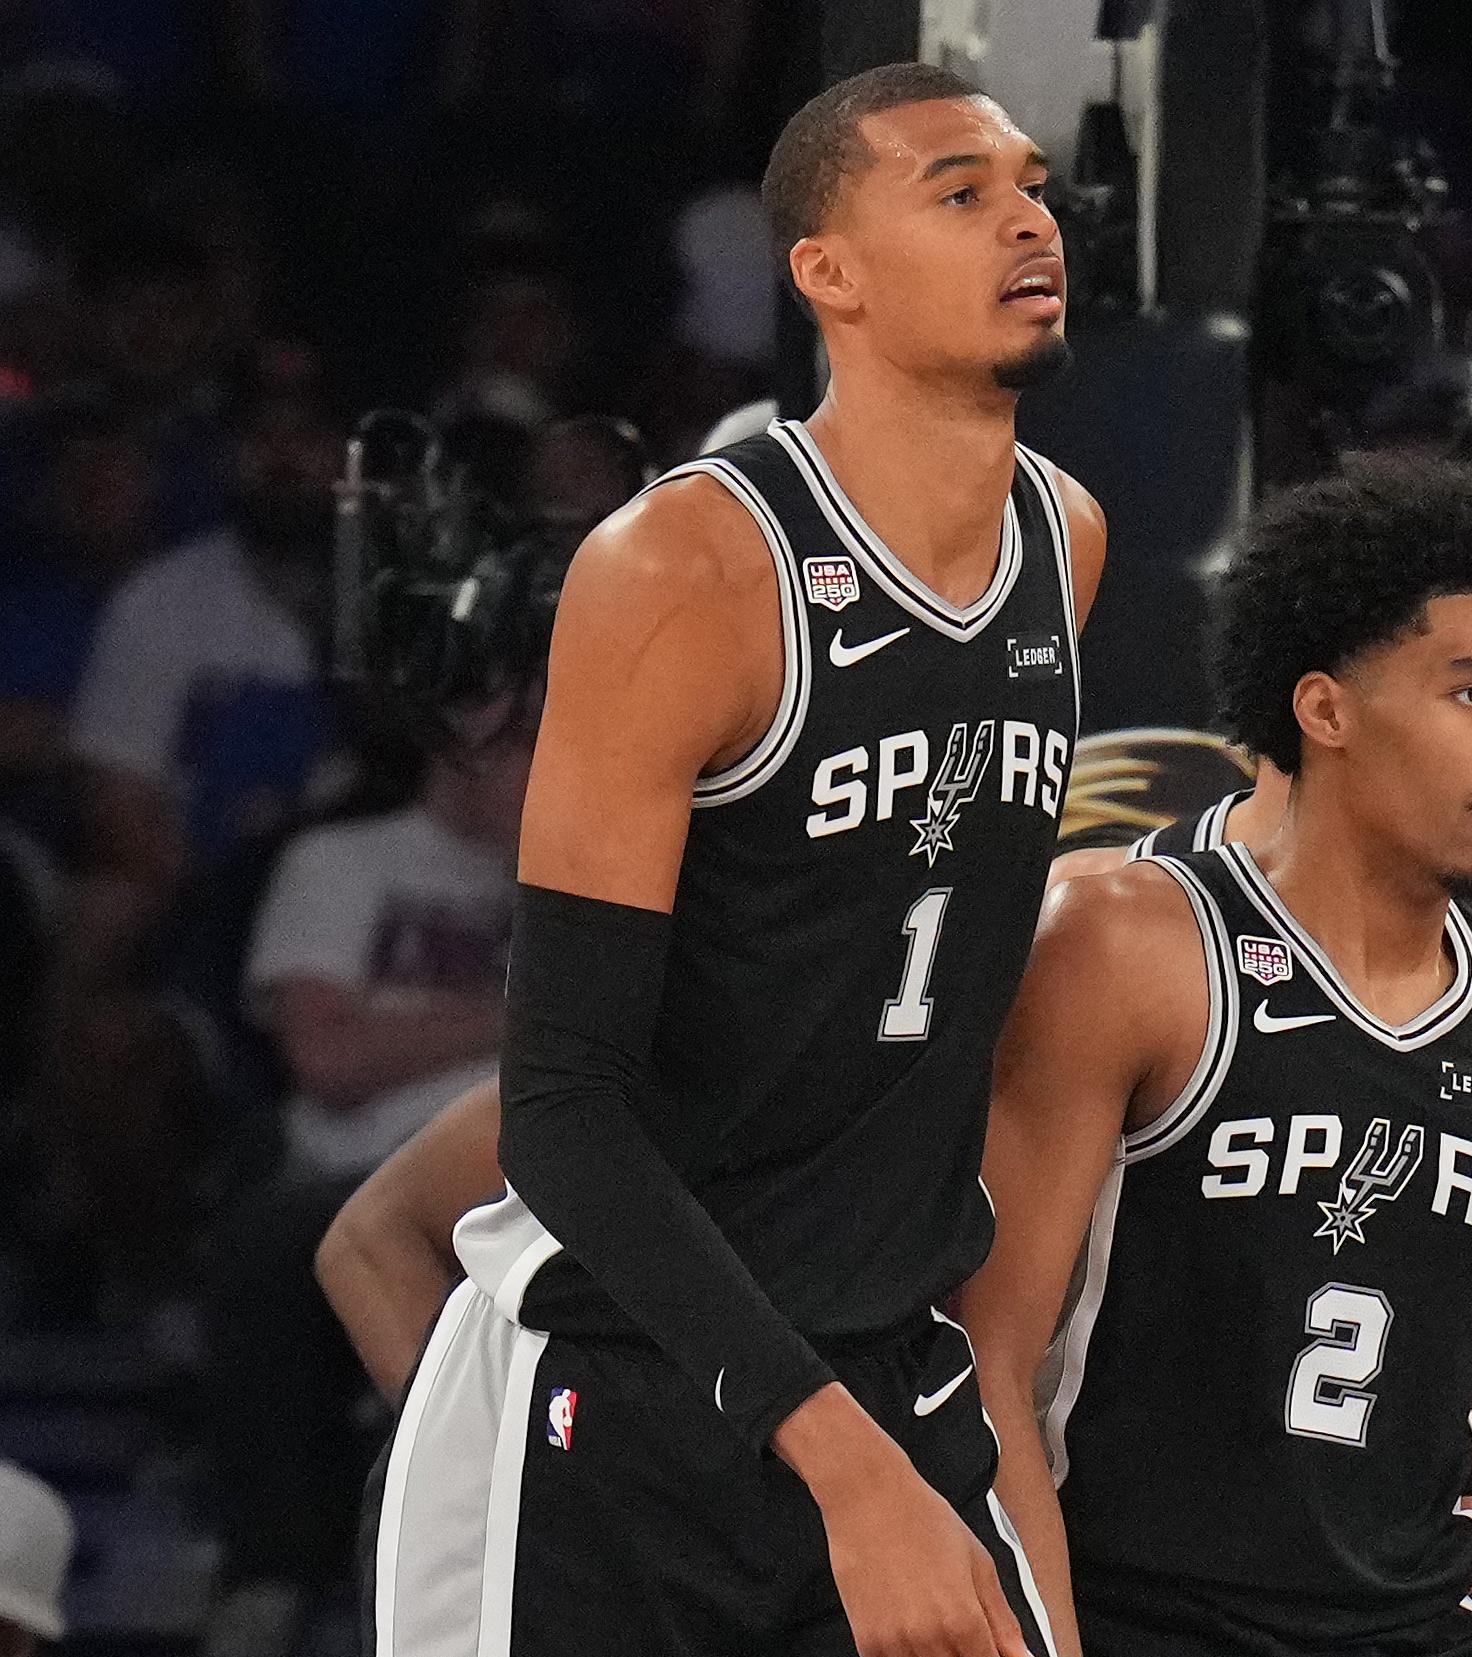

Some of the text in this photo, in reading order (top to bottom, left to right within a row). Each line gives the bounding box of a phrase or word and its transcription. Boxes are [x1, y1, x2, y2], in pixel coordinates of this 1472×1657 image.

[810, 564, 850, 577] USA
[812, 584, 856, 598] 250
[1015, 647, 1056, 667] LEDGER
[805, 720, 1068, 868] SPURS
[1243, 942, 1285, 958] USA
[876, 886, 954, 1042] 1
[1244, 959, 1288, 976] 250
[1284, 1281, 1396, 1449] 2
